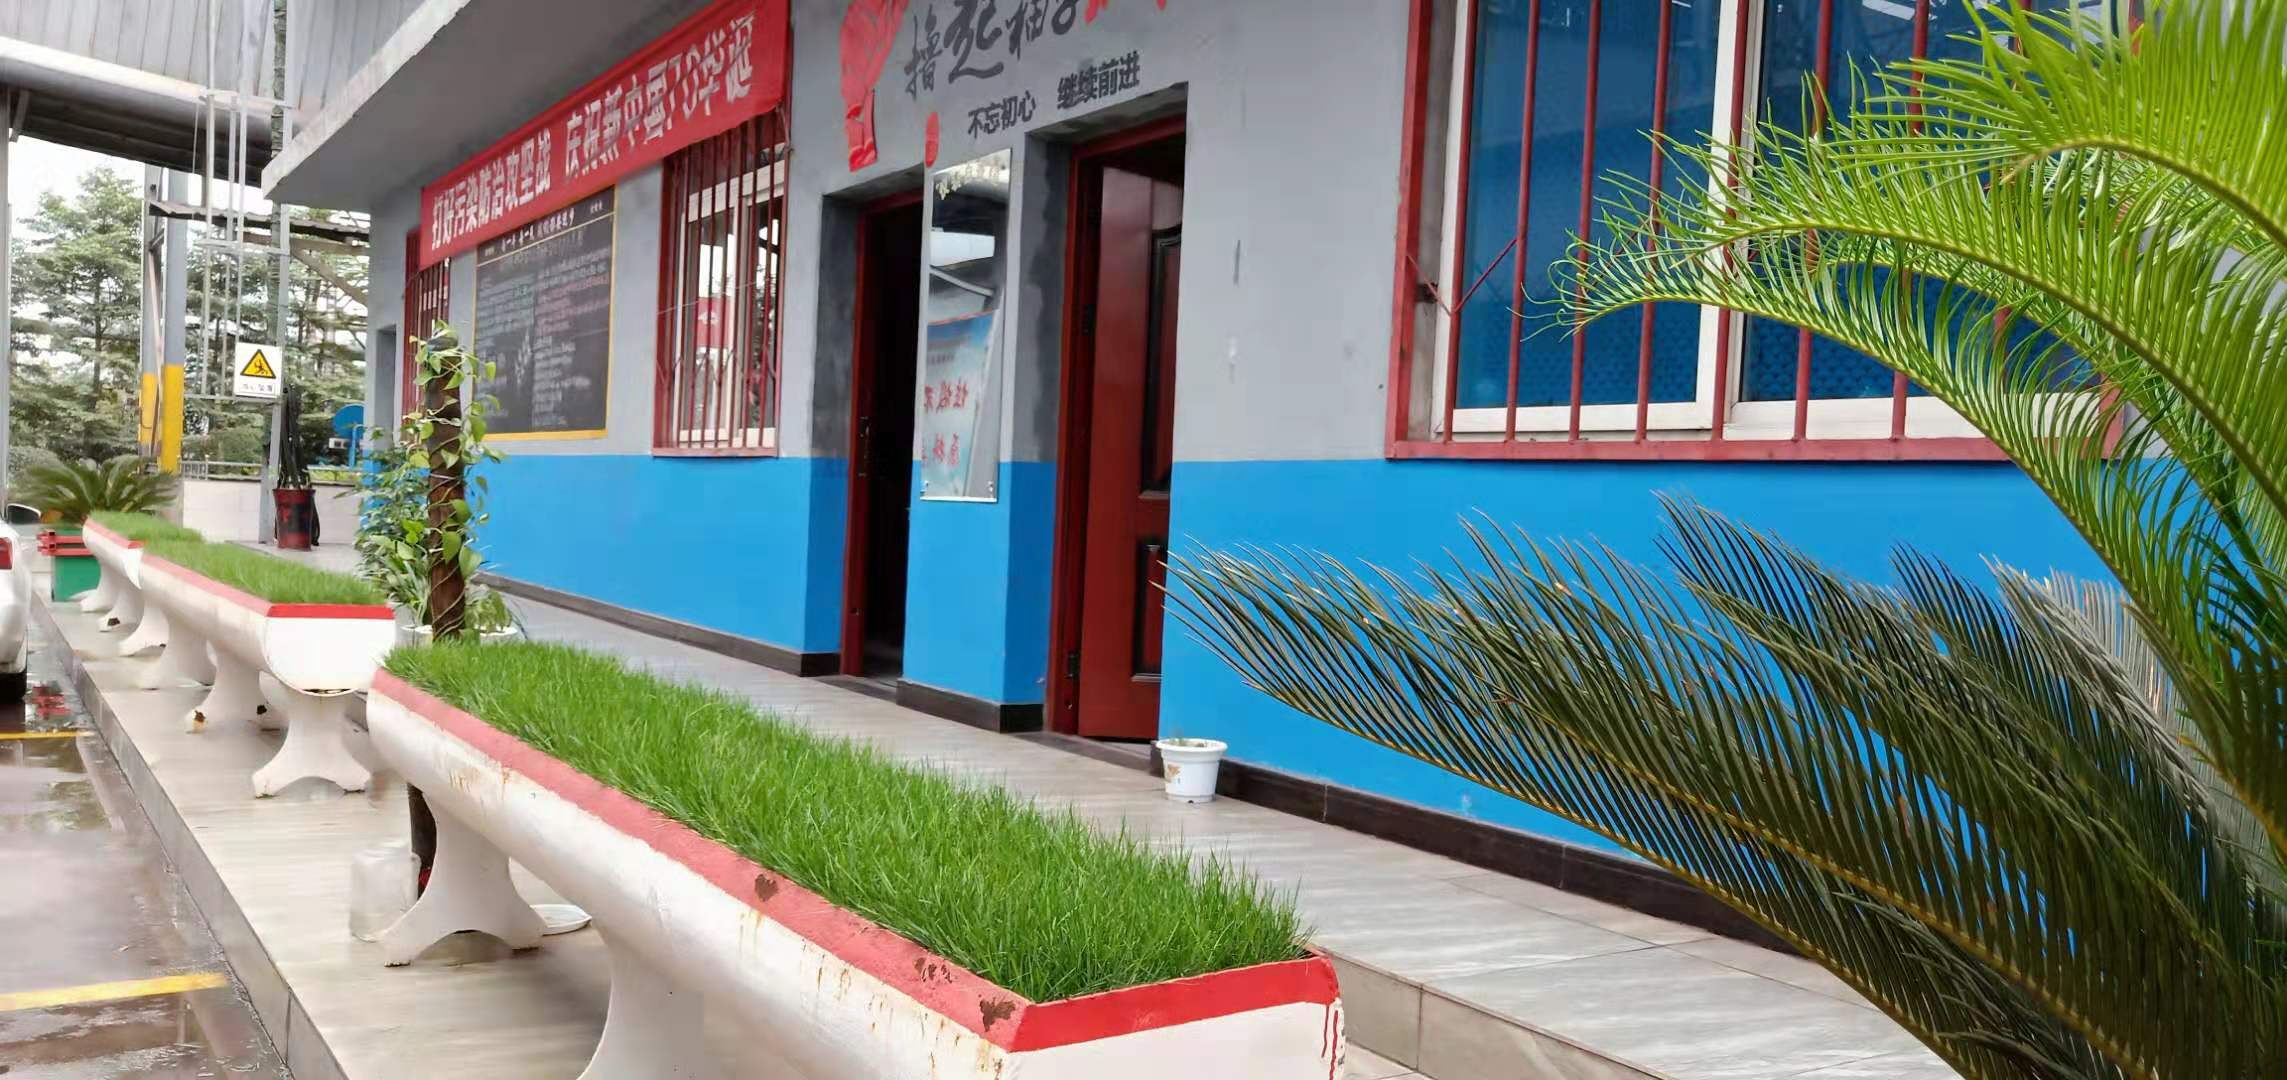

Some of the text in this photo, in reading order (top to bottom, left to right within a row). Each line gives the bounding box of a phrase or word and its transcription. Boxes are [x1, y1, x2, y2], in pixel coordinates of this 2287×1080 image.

[432, 11, 755, 251] 打好污染防治攻坚战 庆祝新中国70华诞
[968, 50, 1141, 139] 不忘初心 继续前进
